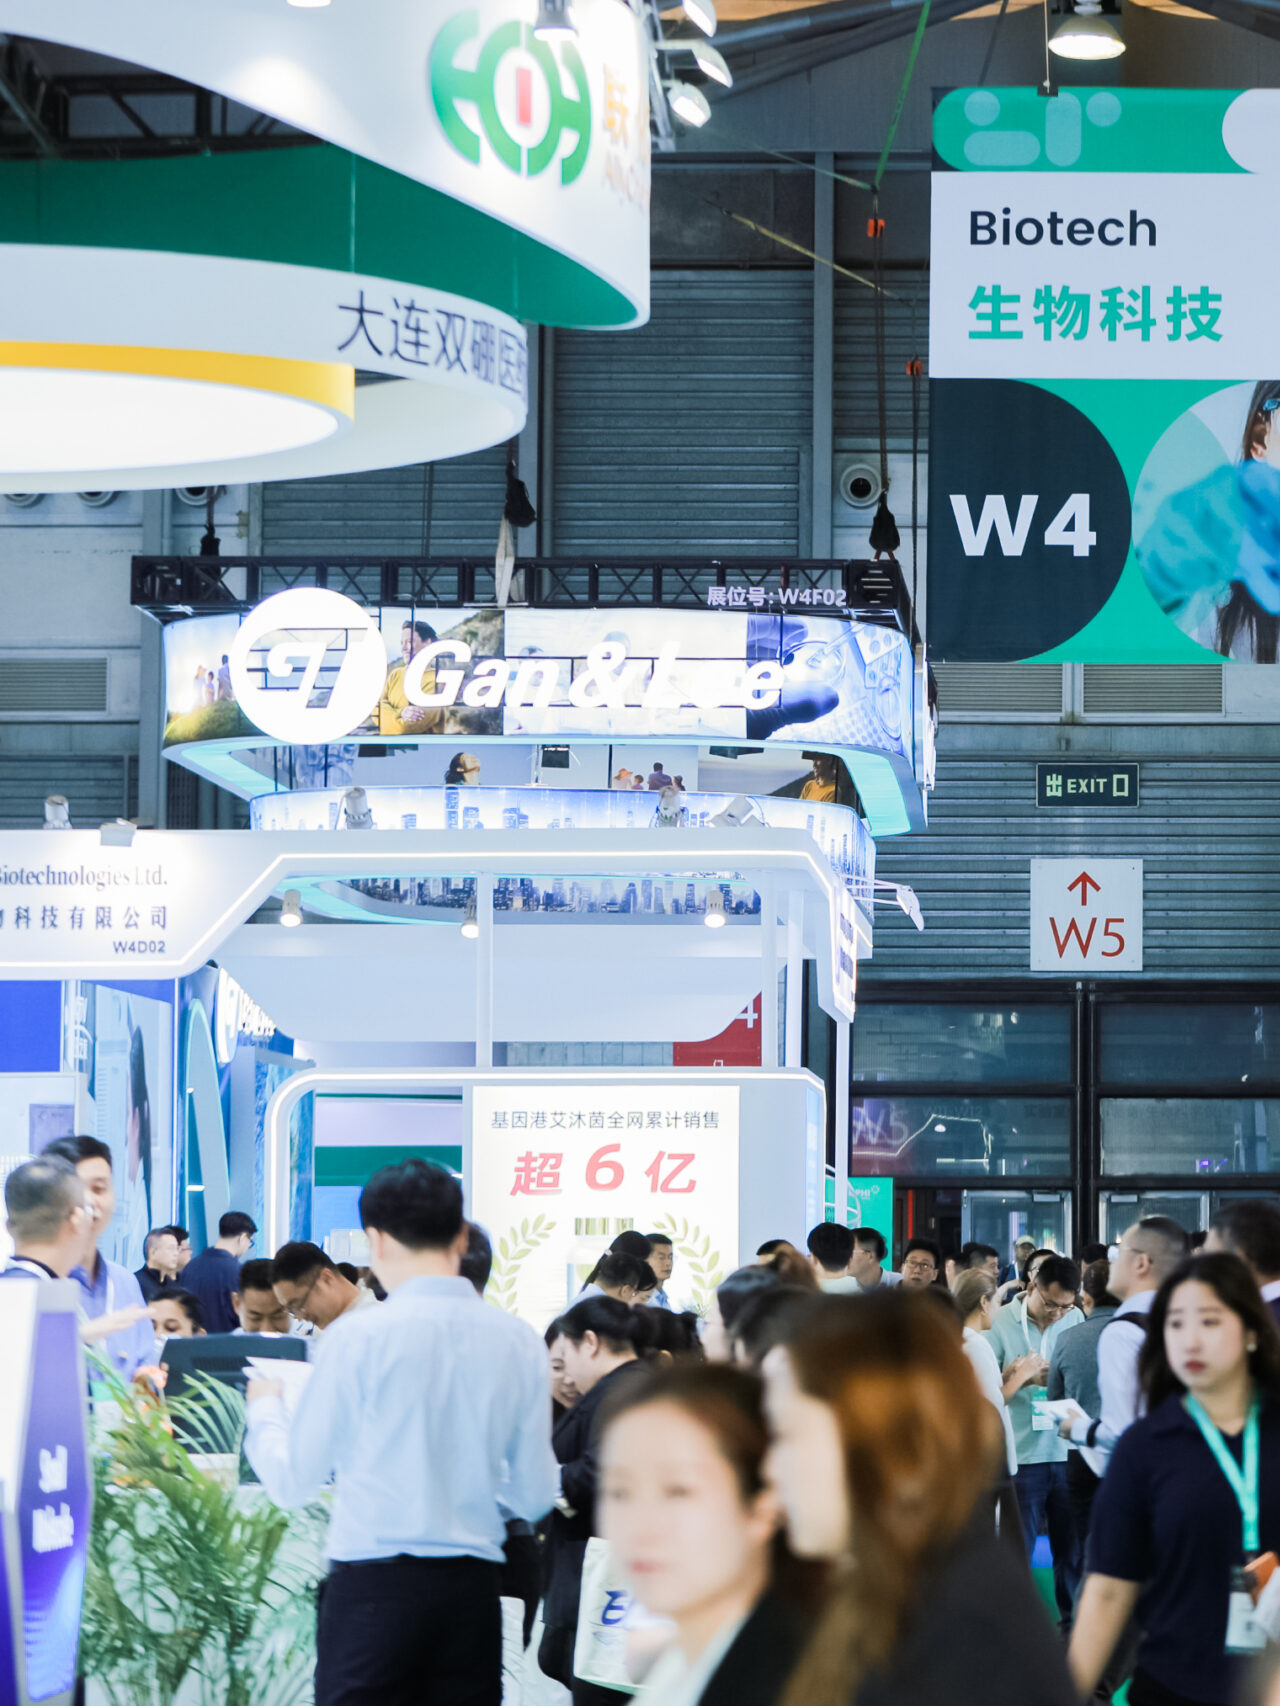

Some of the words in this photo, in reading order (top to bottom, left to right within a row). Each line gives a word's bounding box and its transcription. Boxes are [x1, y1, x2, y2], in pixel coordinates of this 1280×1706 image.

[970, 208, 1158, 247] Biotech
[968, 284, 1223, 342] 生物科技
[949, 493, 1097, 557] W4
[1046, 773, 1063, 797] 出
[1067, 778, 1108, 794] EXIT
[1112, 773, 1129, 797] 口
[0, 905, 167, 930] 科技有限公司
[112, 940, 166, 954] W4D02
[1049, 917, 1125, 959] W5
[491, 1110, 720, 1130] 基因港艾沐菌全网累计销售
